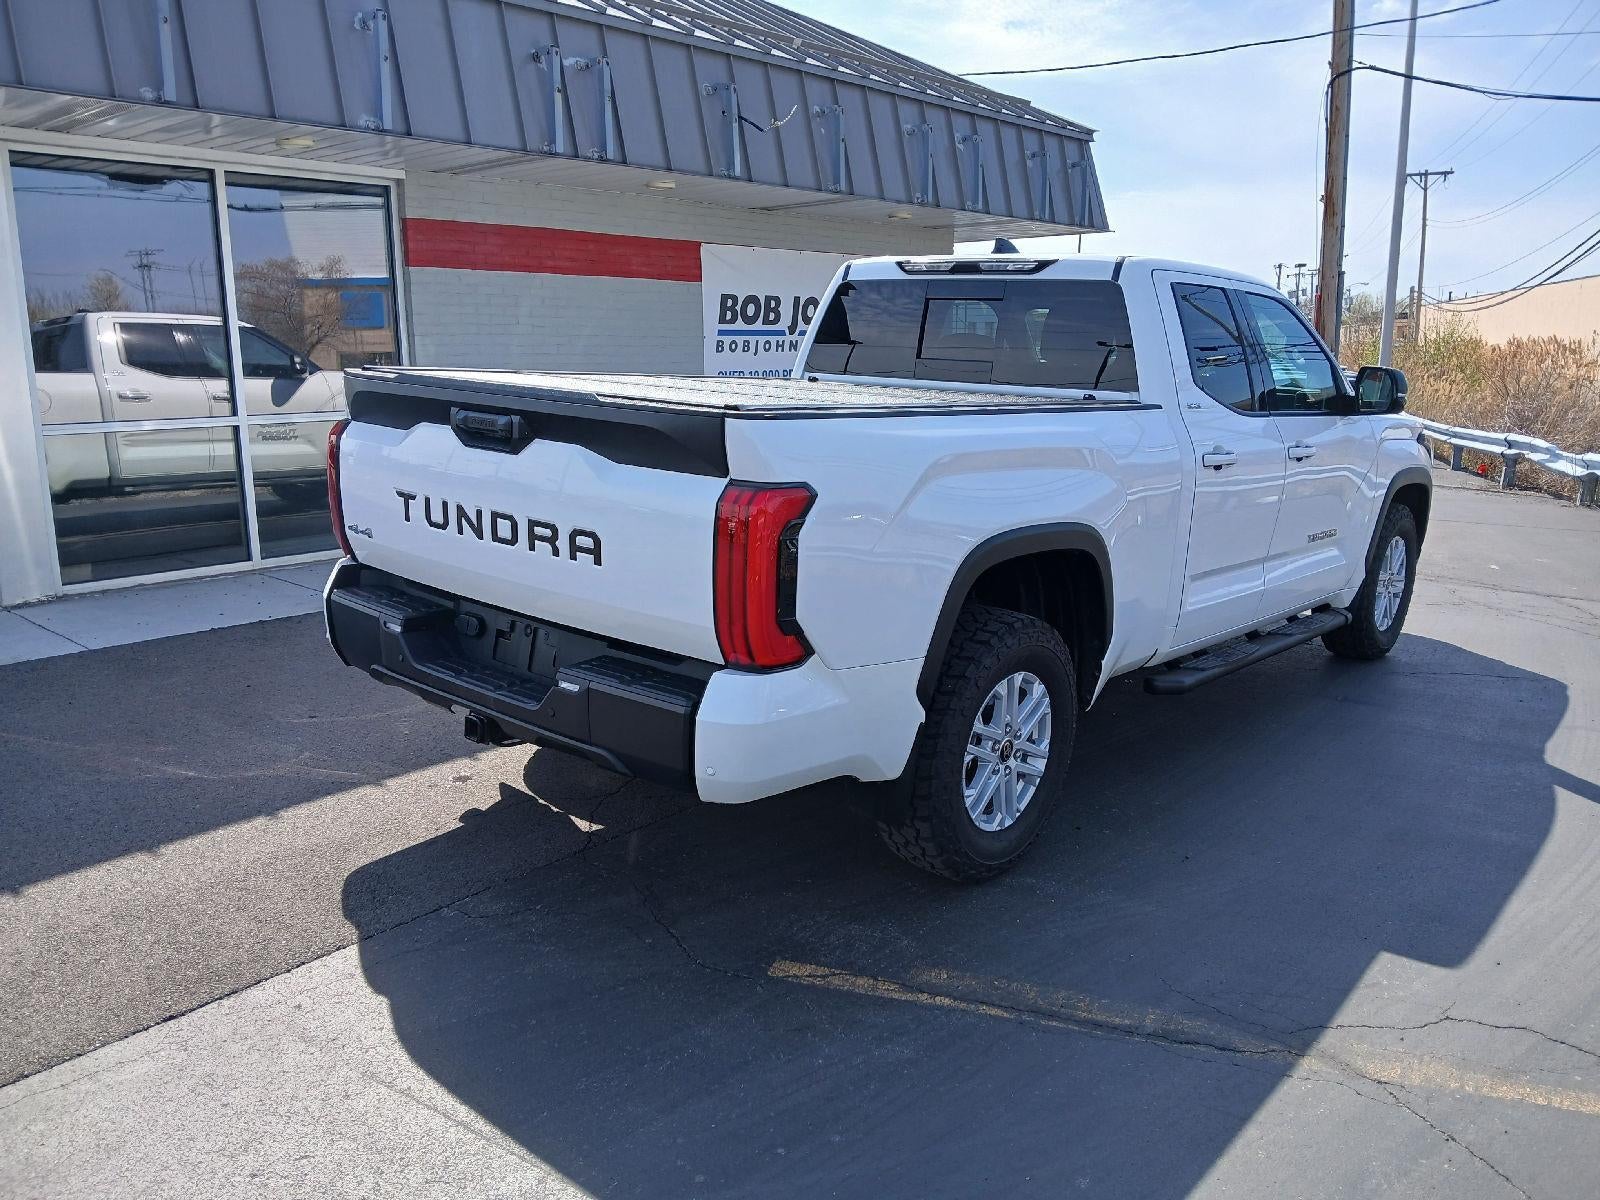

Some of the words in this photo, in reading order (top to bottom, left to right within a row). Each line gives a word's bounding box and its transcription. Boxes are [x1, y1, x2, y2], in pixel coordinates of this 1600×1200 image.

[718, 293, 782, 325] BOB
[787, 295, 820, 335] JO
[715, 339, 798, 356] BOBJOHN
[748, 370, 780, 378] 10000
[394, 487, 603, 567] TUNDRA
